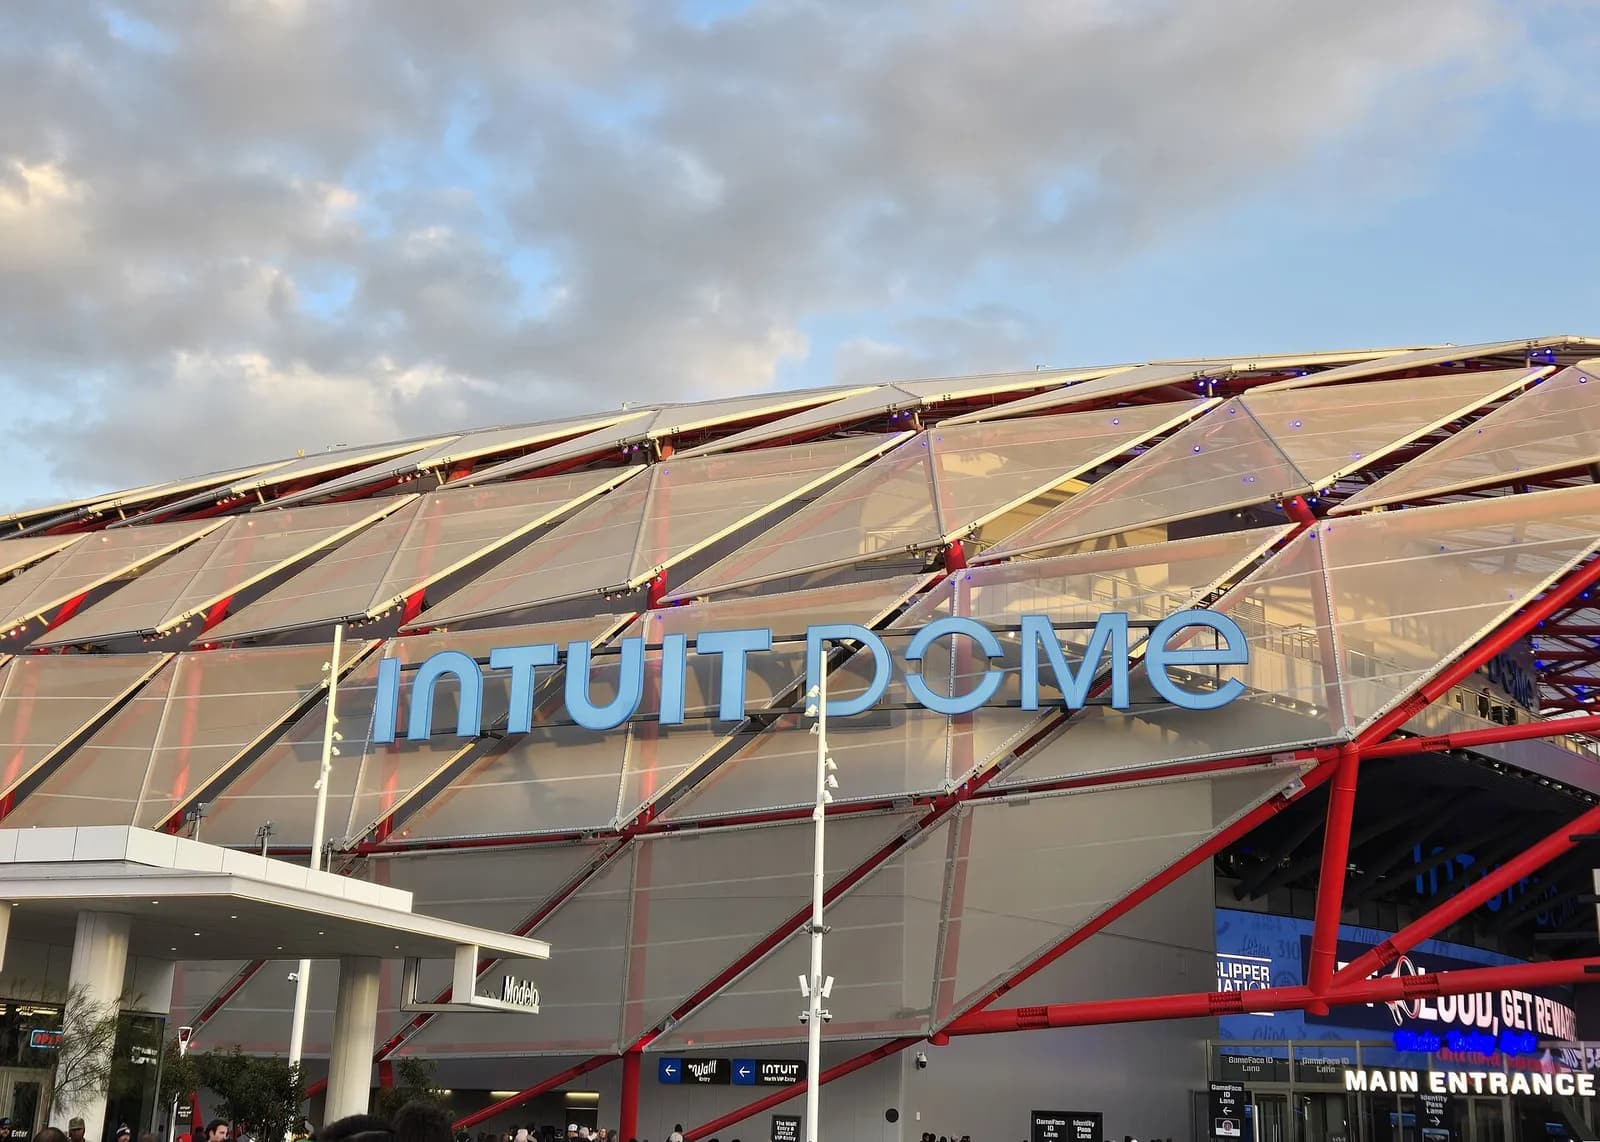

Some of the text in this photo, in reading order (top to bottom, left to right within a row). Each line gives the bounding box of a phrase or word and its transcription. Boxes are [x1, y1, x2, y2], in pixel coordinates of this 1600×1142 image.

[1217, 961, 1270, 982] LIPPER
[501, 975, 539, 1007] Modelo
[1501, 989, 1533, 1031] GET
[1228, 1056, 1265, 1065] GameFace
[1302, 1057, 1349, 1065] GameFace ID
[762, 1064, 799, 1074] INTUIT
[1316, 1065, 1335, 1073] Lane
[1211, 1084, 1242, 1092] GameFace
[1345, 1071, 1596, 1097] MAIN ENTRANCE
[1073, 1120, 1095, 1128] Identity
[11, 1129, 28, 1139] Enter
